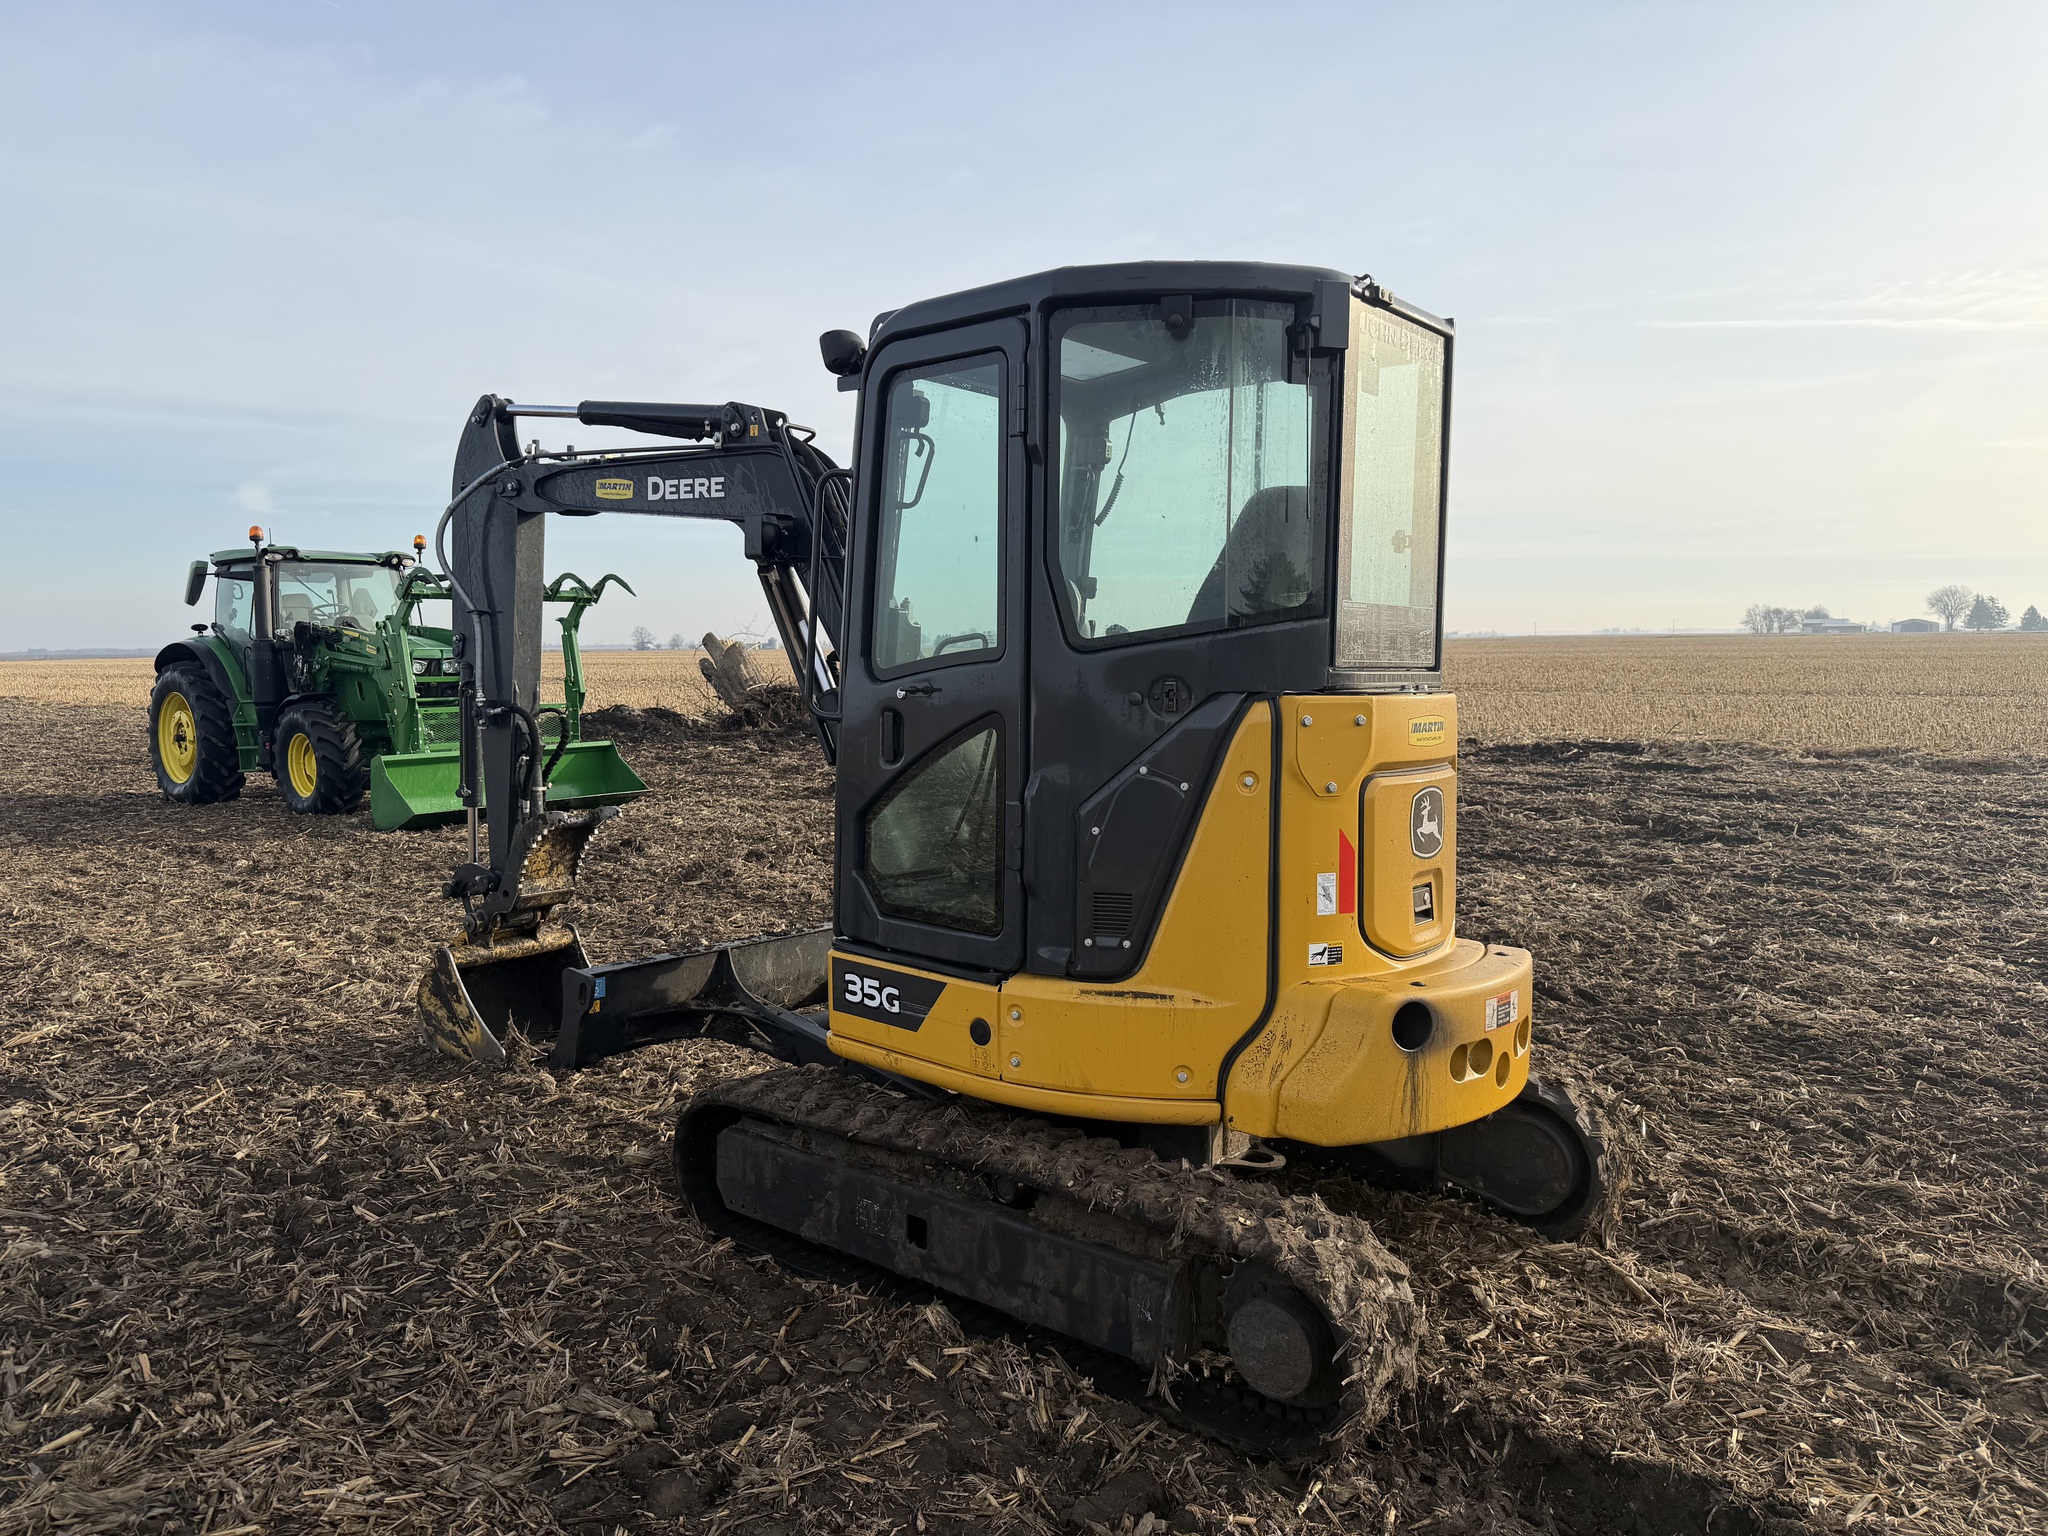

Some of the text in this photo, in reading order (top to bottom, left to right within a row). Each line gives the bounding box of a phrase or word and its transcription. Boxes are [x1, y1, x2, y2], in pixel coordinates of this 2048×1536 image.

[1360, 312, 1396, 347] JOHN
[599, 482, 632, 491] MARTIN
[647, 476, 724, 500] DEERE
[1411, 721, 1444, 733] MARTIN
[844, 973, 899, 1012] 35G
